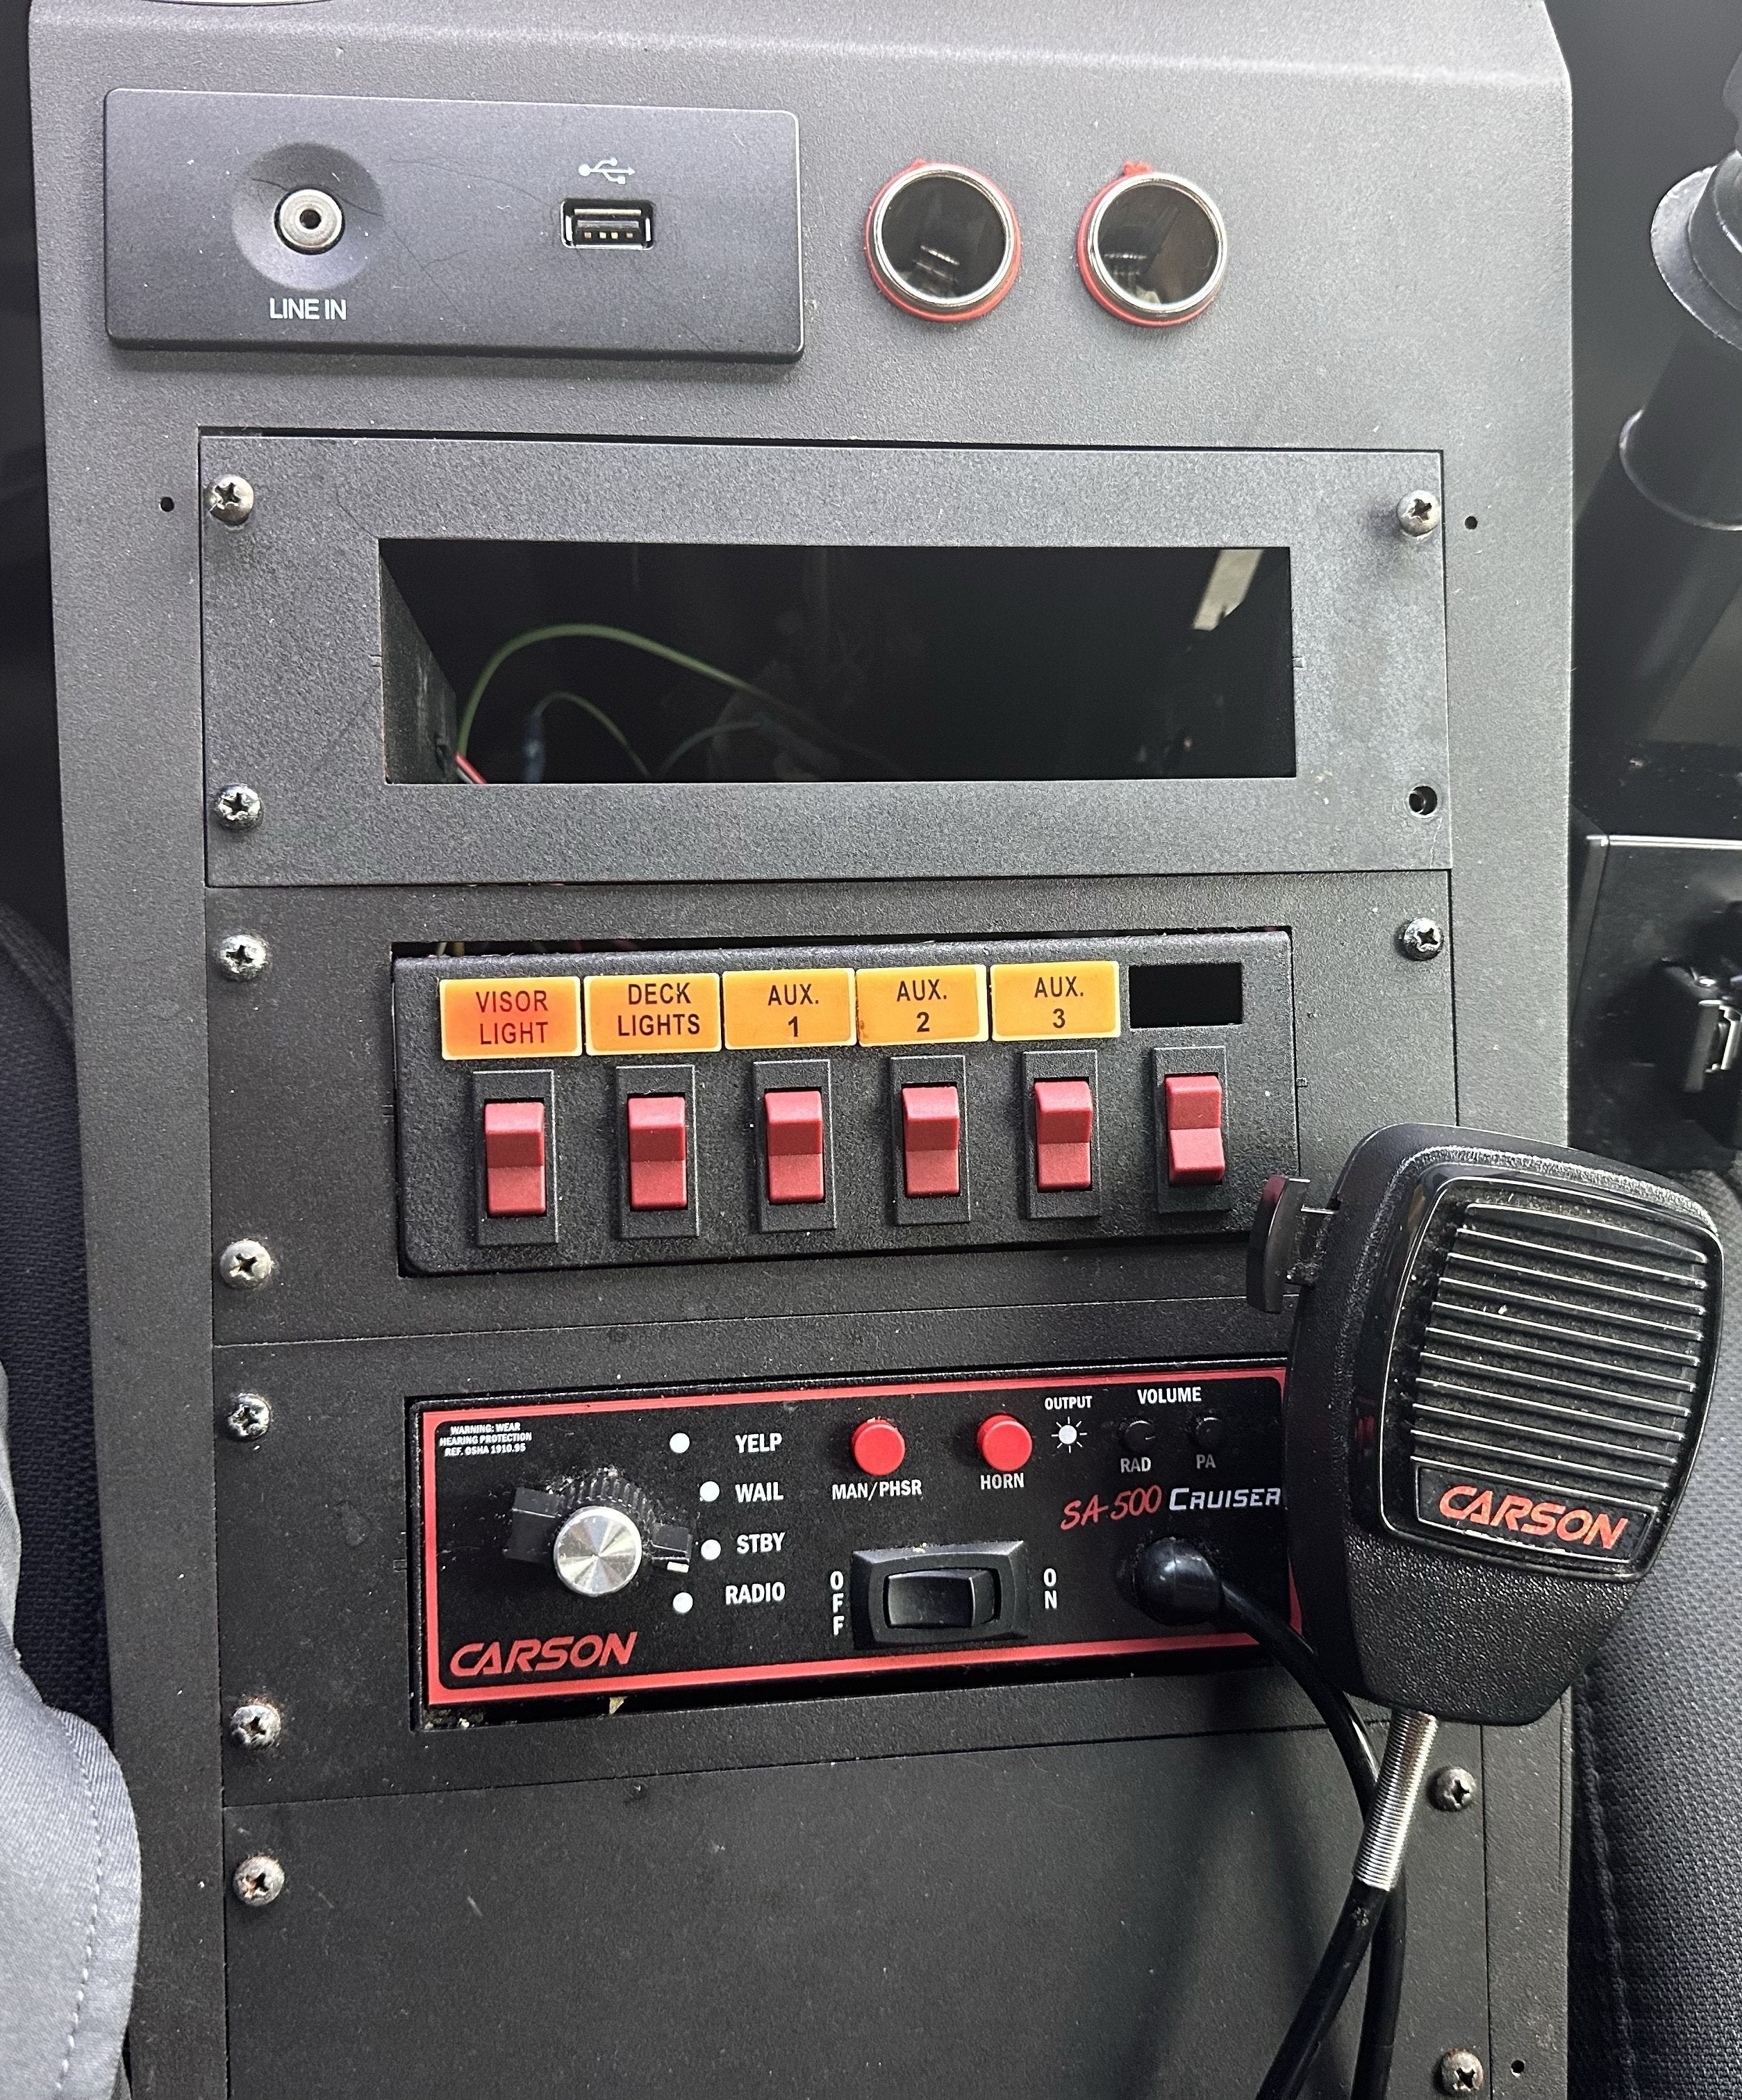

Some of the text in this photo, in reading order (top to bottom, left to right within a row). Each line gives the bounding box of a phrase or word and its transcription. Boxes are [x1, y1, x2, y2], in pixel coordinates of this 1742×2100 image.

[269, 298, 347, 320] LINE IN
[628, 982, 691, 1005] DECK
[768, 983, 820, 1006] AUX.
[896, 979, 947, 1002] AUX.
[1034, 976, 1084, 999] AUX.
[476, 990, 549, 1012] VISOR
[617, 1014, 700, 1036] LIGHTS
[788, 1016, 799, 1038] 1
[916, 1012, 930, 1033] 2
[1052, 1008, 1066, 1028] 3
[480, 1022, 549, 1044] LIGHT
[1045, 1396, 1093, 1410] OUTPUT
[1137, 1387, 1202, 1404] VOLUME
[439, 1432, 532, 1447] HEARING PROTECTION
[450, 1422, 521, 1435] WARNING: WEAR
[445, 1442, 526, 1457] REF. OSHA 1910.95
[735, 1433, 783, 1453] YELP
[1120, 1457, 1152, 1473] RAD
[1196, 1454, 1216, 1469] PA
[735, 1481, 784, 1503] WAIL
[832, 1479, 922, 1501] MAN/PHSR
[980, 1472, 1025, 1490] HORN
[1061, 1485, 1281, 1530] SA-500 CRUISER
[1439, 1485, 1628, 1549] CARSON
[736, 1532, 786, 1554] STBY
[725, 1581, 786, 1605] RADIO
[1043, 1568, 1057, 1610] ON
[830, 1570, 845, 1635] OFF
[449, 1632, 638, 1676] CARSON
